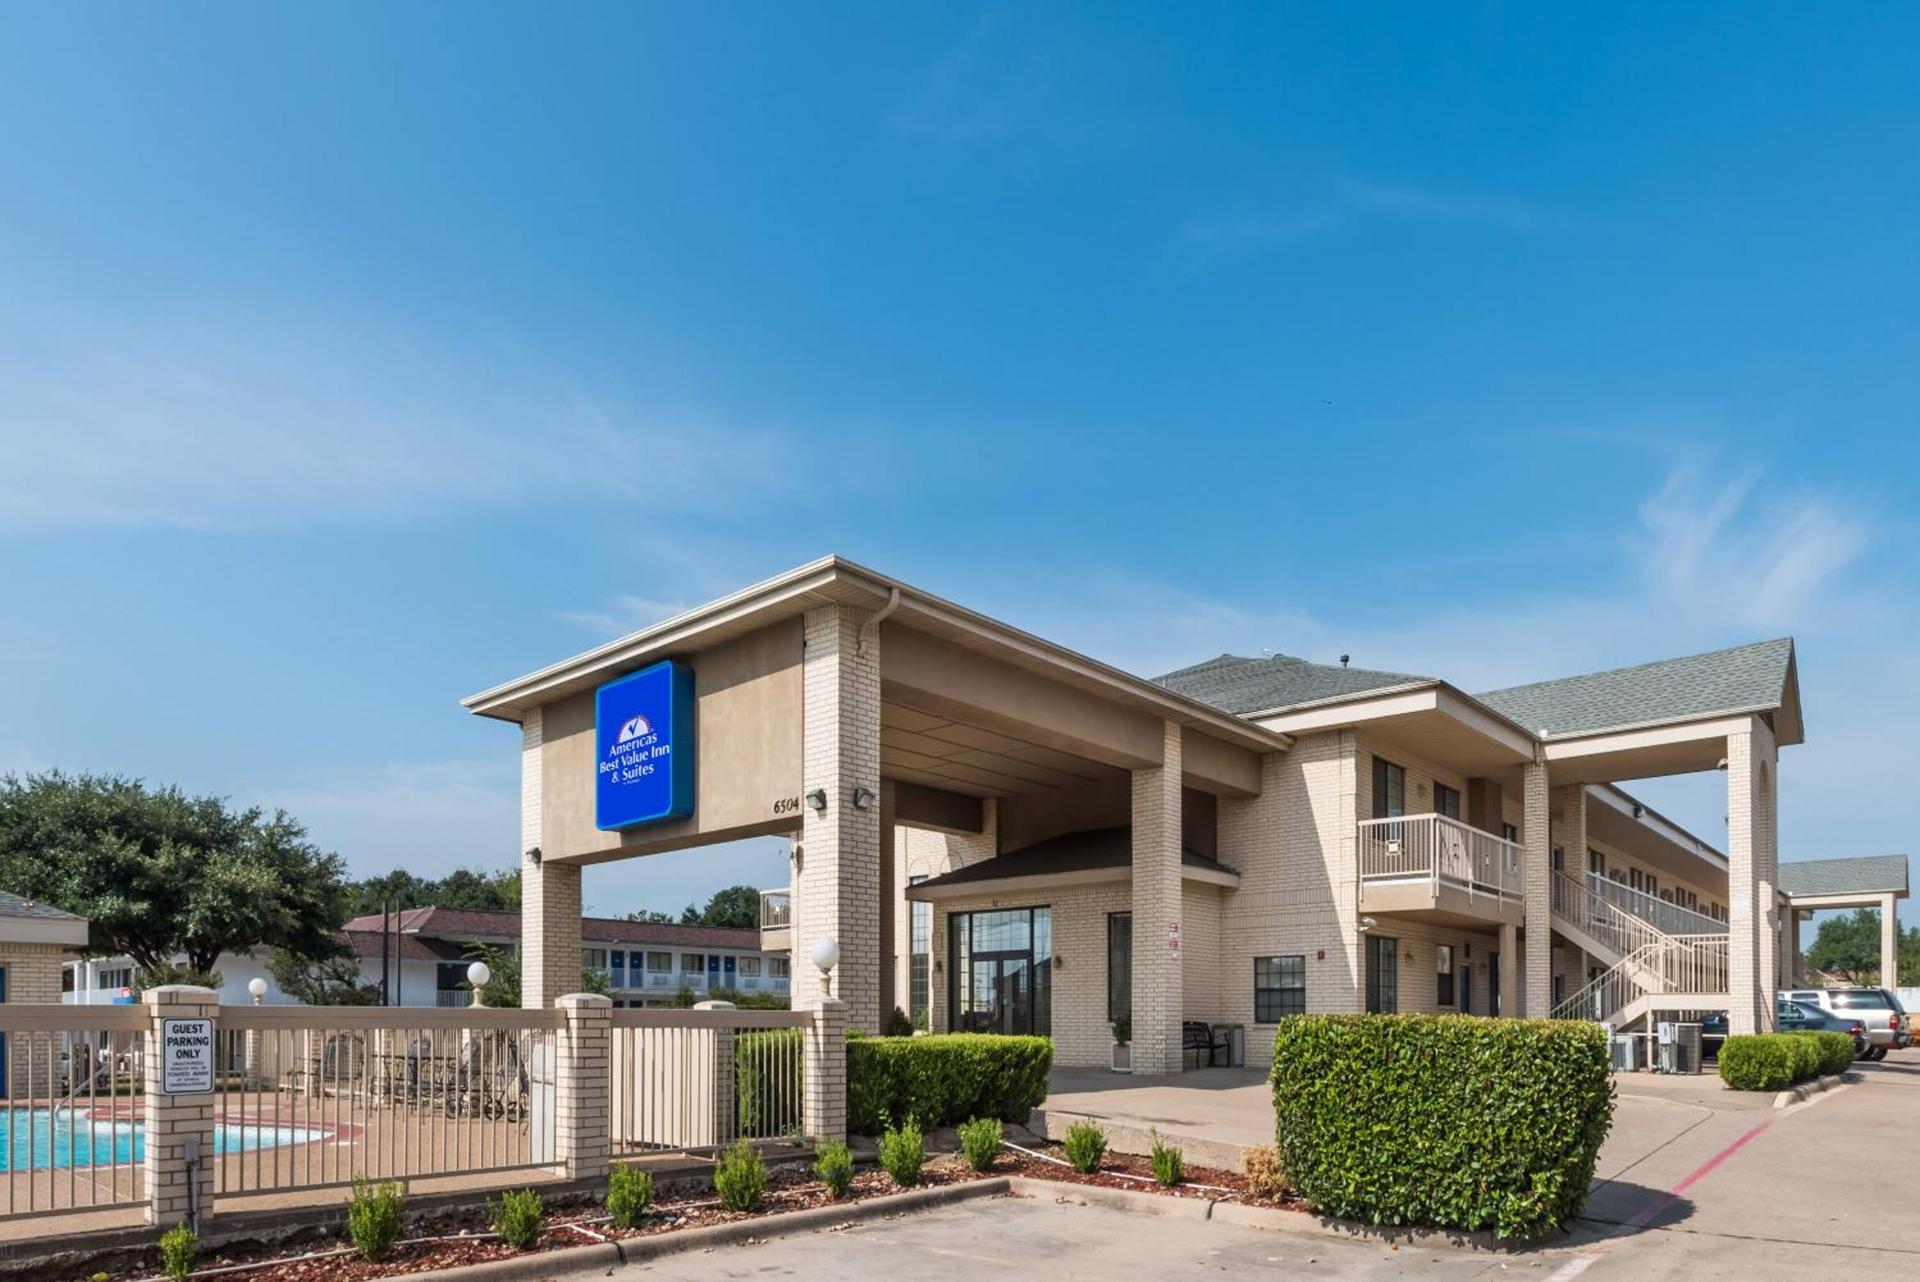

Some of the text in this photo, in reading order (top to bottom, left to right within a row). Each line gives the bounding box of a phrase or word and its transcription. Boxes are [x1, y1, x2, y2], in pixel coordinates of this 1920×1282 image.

[599, 744, 670, 774] Best Value Inn
[611, 763, 654, 783] & Suites
[774, 797, 800, 814] 6504
[172, 1024, 204, 1034] GUEST
[167, 1036, 209, 1047] PARKING
[175, 1049, 201, 1059] ONLY
